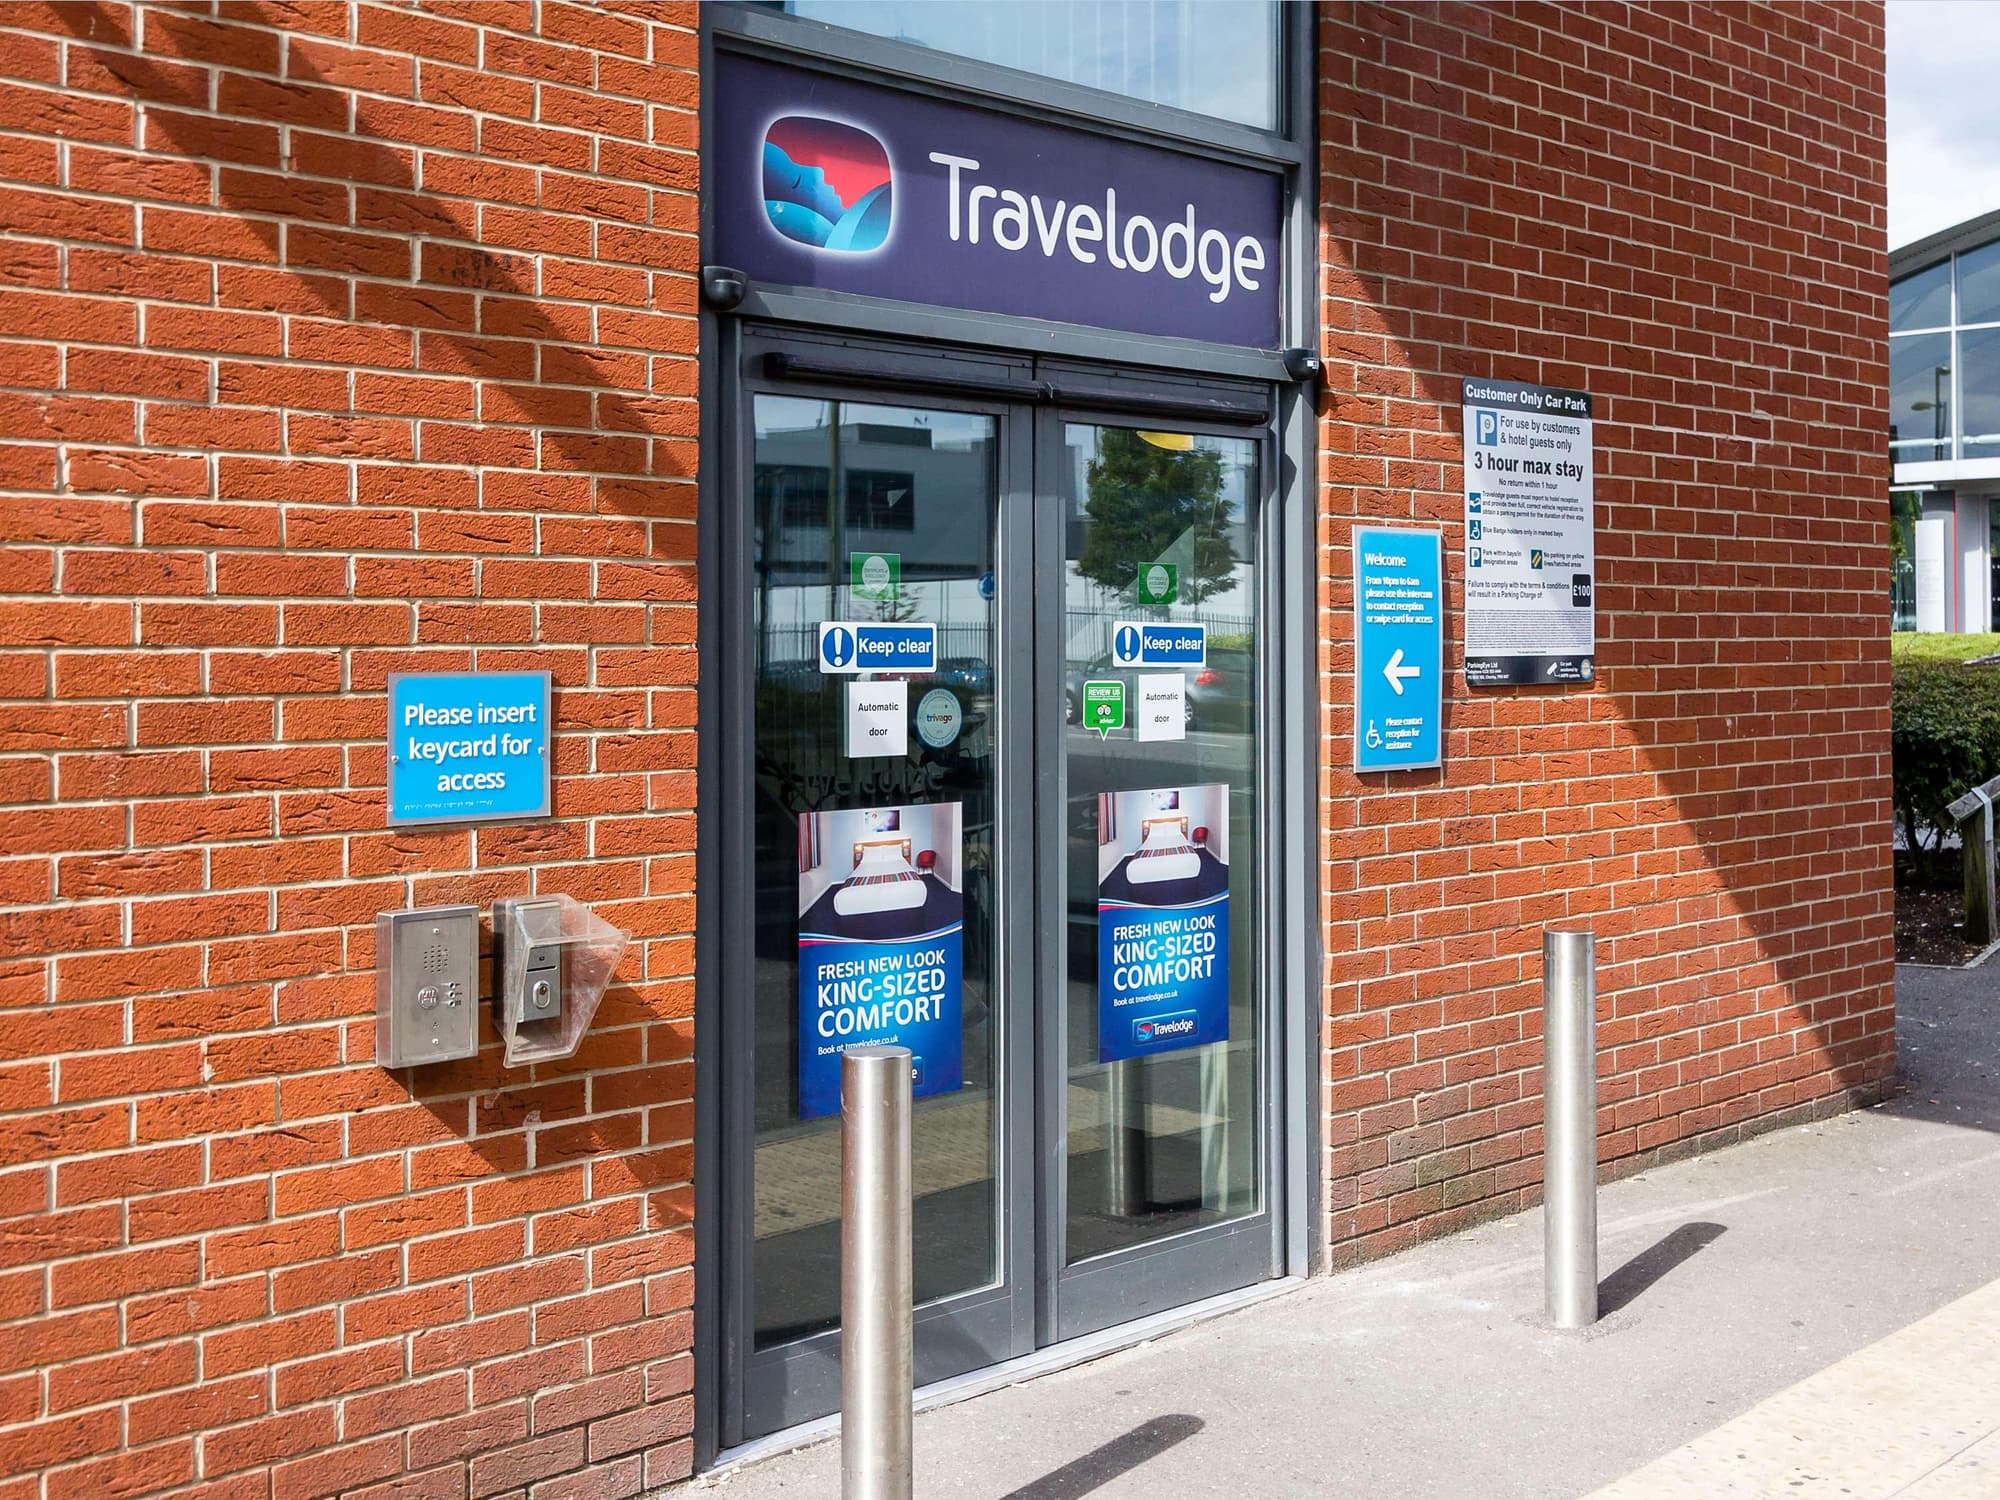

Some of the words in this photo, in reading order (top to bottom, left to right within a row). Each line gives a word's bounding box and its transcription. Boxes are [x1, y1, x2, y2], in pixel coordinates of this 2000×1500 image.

[928, 151, 1266, 304] Travelodge
[1466, 384, 1517, 403] Customer
[1520, 391, 1543, 408] Only
[1545, 394, 1563, 408] Car
[1565, 397, 1586, 412] Park
[1500, 415, 1513, 428] For
[1516, 419, 1529, 430] use
[1531, 419, 1541, 433] by
[1543, 422, 1581, 435] customers
[1500, 432, 1506, 443] &
[1509, 433, 1528, 446] hotel
[1530, 438, 1555, 449] guests
[1556, 439, 1572, 453] only
[1474, 451, 1483, 470] 3
[1488, 452, 1518, 473] hour
[1523, 460, 1552, 475] max
[1556, 460, 1584, 482] stay
[1499, 478, 1506, 486] No
[1507, 479, 1524, 488] return
[1525, 481, 1540, 489] within
[1546, 482, 1558, 490] hour
[1524, 529, 1532, 537] only
[1365, 551, 1406, 567] Welcome
[1550, 552, 1565, 560] parking
[1571, 553, 1584, 561] yellow
[1366, 576, 1382, 585] From
[1400, 577, 1406, 586] to
[1468, 580, 1484, 588] Failure
[1491, 581, 1508, 590] comply
[1546, 581, 1570, 590] conditions
[1365, 588, 1385, 600] please
[1386, 590, 1396, 598] use
[1397, 588, 1407, 598] the
[1407, 589, 1433, 599] intercom
[1477, 590, 1491, 598] result
[1501, 590, 1519, 600] Parking
[1520, 591, 1536, 600] Charge
[1573, 585, 1591, 597] £100
[1366, 602, 1373, 610] to
[1374, 602, 1395, 611] contact
[1397, 601, 1424, 612] reception
[1366, 615, 1373, 623] or
[1374, 614, 1391, 625] swipe
[1392, 614, 1405, 623] card
[1405, 614, 1414, 623] for
[858, 637, 894, 657] Keep
[898, 638, 932, 653] clear
[1143, 635, 1172, 653] Keep
[1175, 636, 1202, 650] clear
[1088, 688, 1111, 696] REVIEW
[1112, 688, 1120, 696] US
[1145, 692, 1178, 701] Automatic
[405, 703, 472, 726] Please
[478, 702, 536, 724] insert
[858, 702, 899, 712] Automatic
[927, 713, 952, 724] trivago
[1154, 714, 1169, 723] door
[869, 727, 888, 736] door
[409, 733, 496, 764] keycard
[501, 733, 532, 756] for
[437, 771, 506, 792] access
[1114, 923, 1151, 941] FRESH
[1154, 919, 1181, 936] NEW
[1184, 914, 1216, 932] LOOK
[1113, 931, 1216, 965] KING-SIZED
[818, 960, 864, 981] FRESH
[868, 955, 903, 974] NEW
[906, 949, 945, 969] LOOK
[1113, 954, 1216, 991] COMFORT
[818, 968, 945, 1008] KING-SIZED
[1113, 998, 1128, 1007] Book
[1135, 990, 1178, 1004] travelodge.co.uk
[818, 993, 945, 1038] COMFORT
[1153, 1019, 1193, 1036] Travelodge
[818, 1044, 835, 1056] Book
[836, 1044, 844, 1053] at
